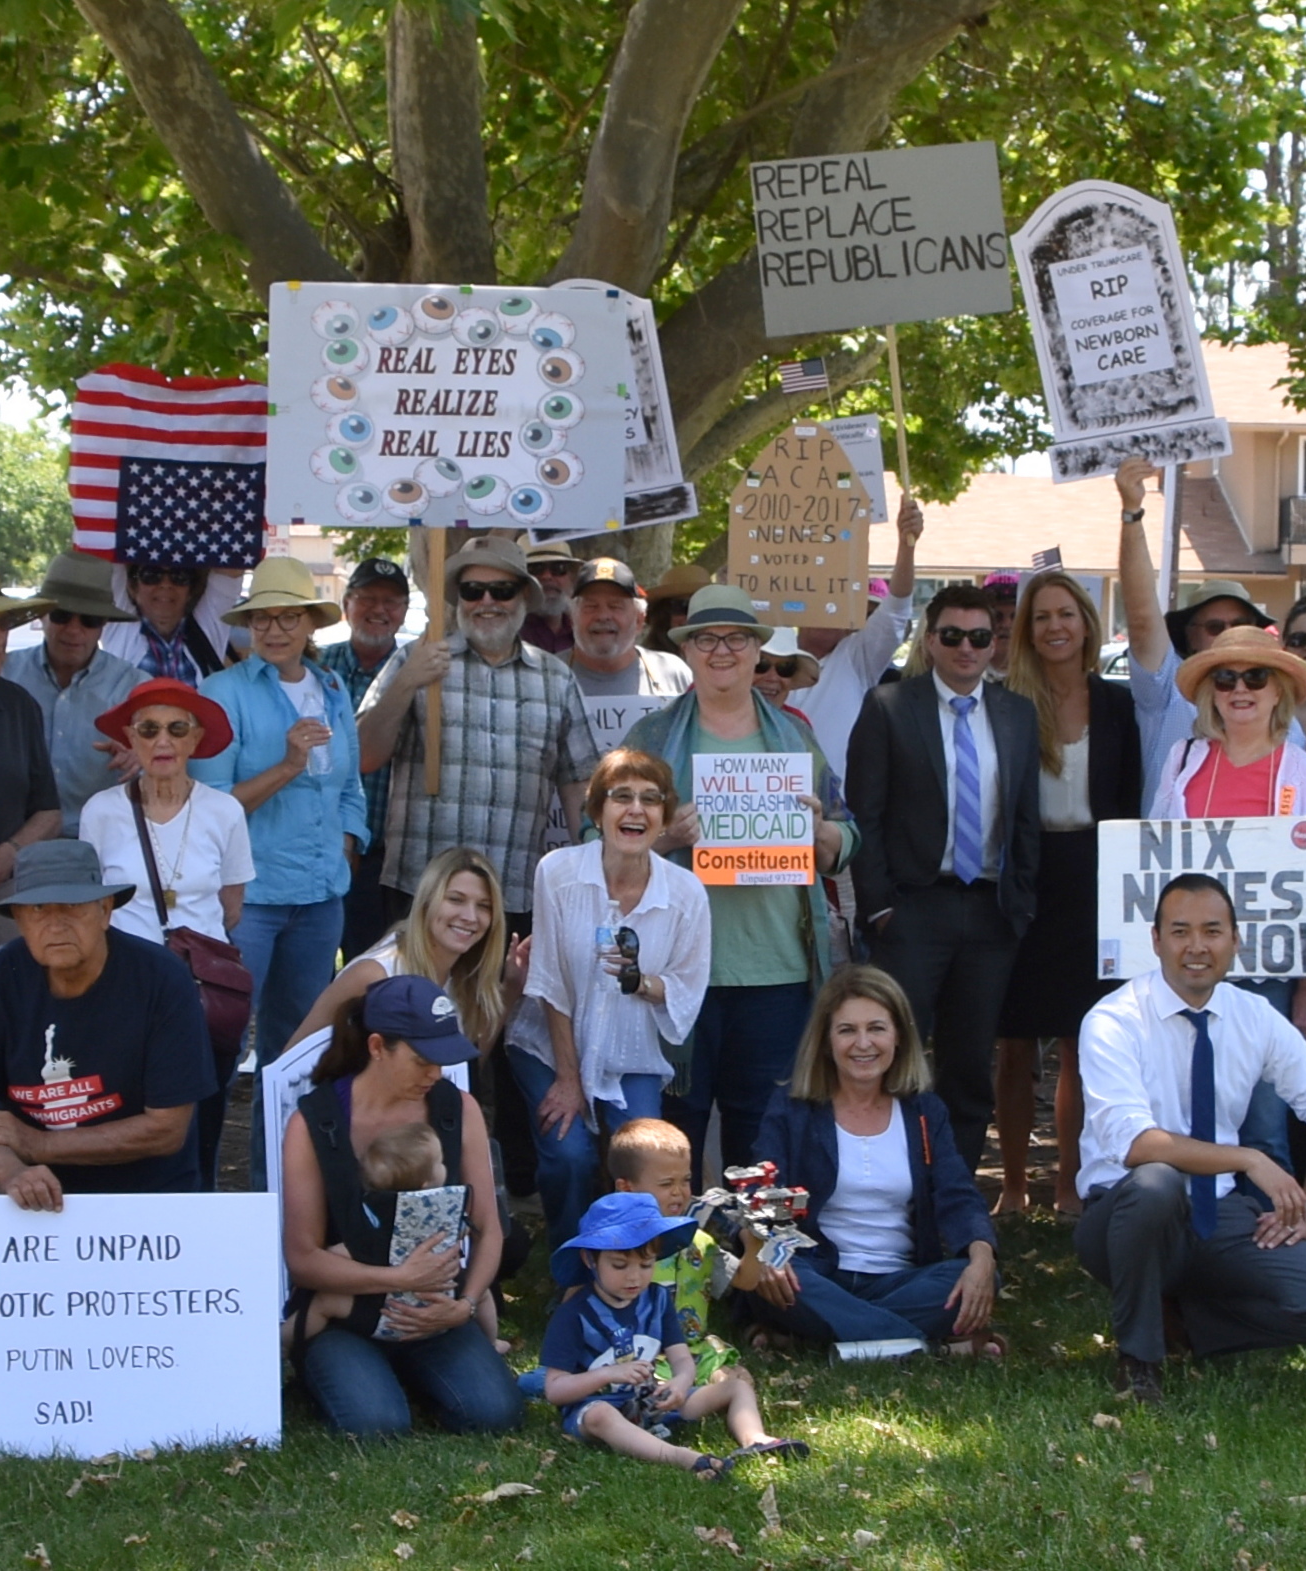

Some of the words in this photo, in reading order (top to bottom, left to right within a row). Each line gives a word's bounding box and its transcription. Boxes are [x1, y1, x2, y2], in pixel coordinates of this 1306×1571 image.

[753, 157, 887, 200] REPEAL
[757, 197, 916, 244] REPLACE
[762, 232, 1008, 289] REPUBLICANS
[1057, 264, 1087, 277] UNDER
[1091, 252, 1143, 269] TRUMPCARE
[1090, 274, 1128, 299] RIP
[1071, 310, 1127, 331] COVERAGE
[1131, 305, 1155, 318] FOR
[1075, 323, 1159, 352] NEWBORN
[375, 346, 437, 374] REAL
[452, 347, 518, 376] EYES
[1097, 346, 1147, 371] CARE
[393, 388, 499, 417] REALIZE
[378, 430, 440, 457] REAL
[455, 431, 513, 458] LIES
[774, 437, 834, 461] RIP
[759, 465, 833, 489] ACA
[742, 493, 861, 522] 2010-2017
[756, 524, 837, 545] NUNES
[763, 554, 810, 565] VOTED
[736, 574, 759, 592] TO
[769, 575, 816, 592] KILL
[828, 577, 849, 594] IT
[714, 758, 746, 773] HOW
[751, 758, 789, 774] MANY
[701, 776, 758, 793] WILL
[766, 775, 804, 792] DIE
[696, 795, 737, 812] FROM
[740, 794, 809, 812] SLASHING
[1280, 788, 1292, 815] ESIST
[697, 813, 807, 840] MEDICAID
[697, 850, 809, 870] Constituent
[740, 874, 773, 884] Unpaid
[12, 1089, 34, 1101] WE
[37, 1085, 66, 1101] ARE
[69, 1081, 95, 1095] ALL
[29, 1099, 115, 1122] IMMIGRANTS
[2, 1235, 60, 1263] ARE
[76, 1234, 181, 1262] UNPAID
[6, 1347, 73, 1371] PUTIN
[34, 1401, 93, 1425] SAD!
